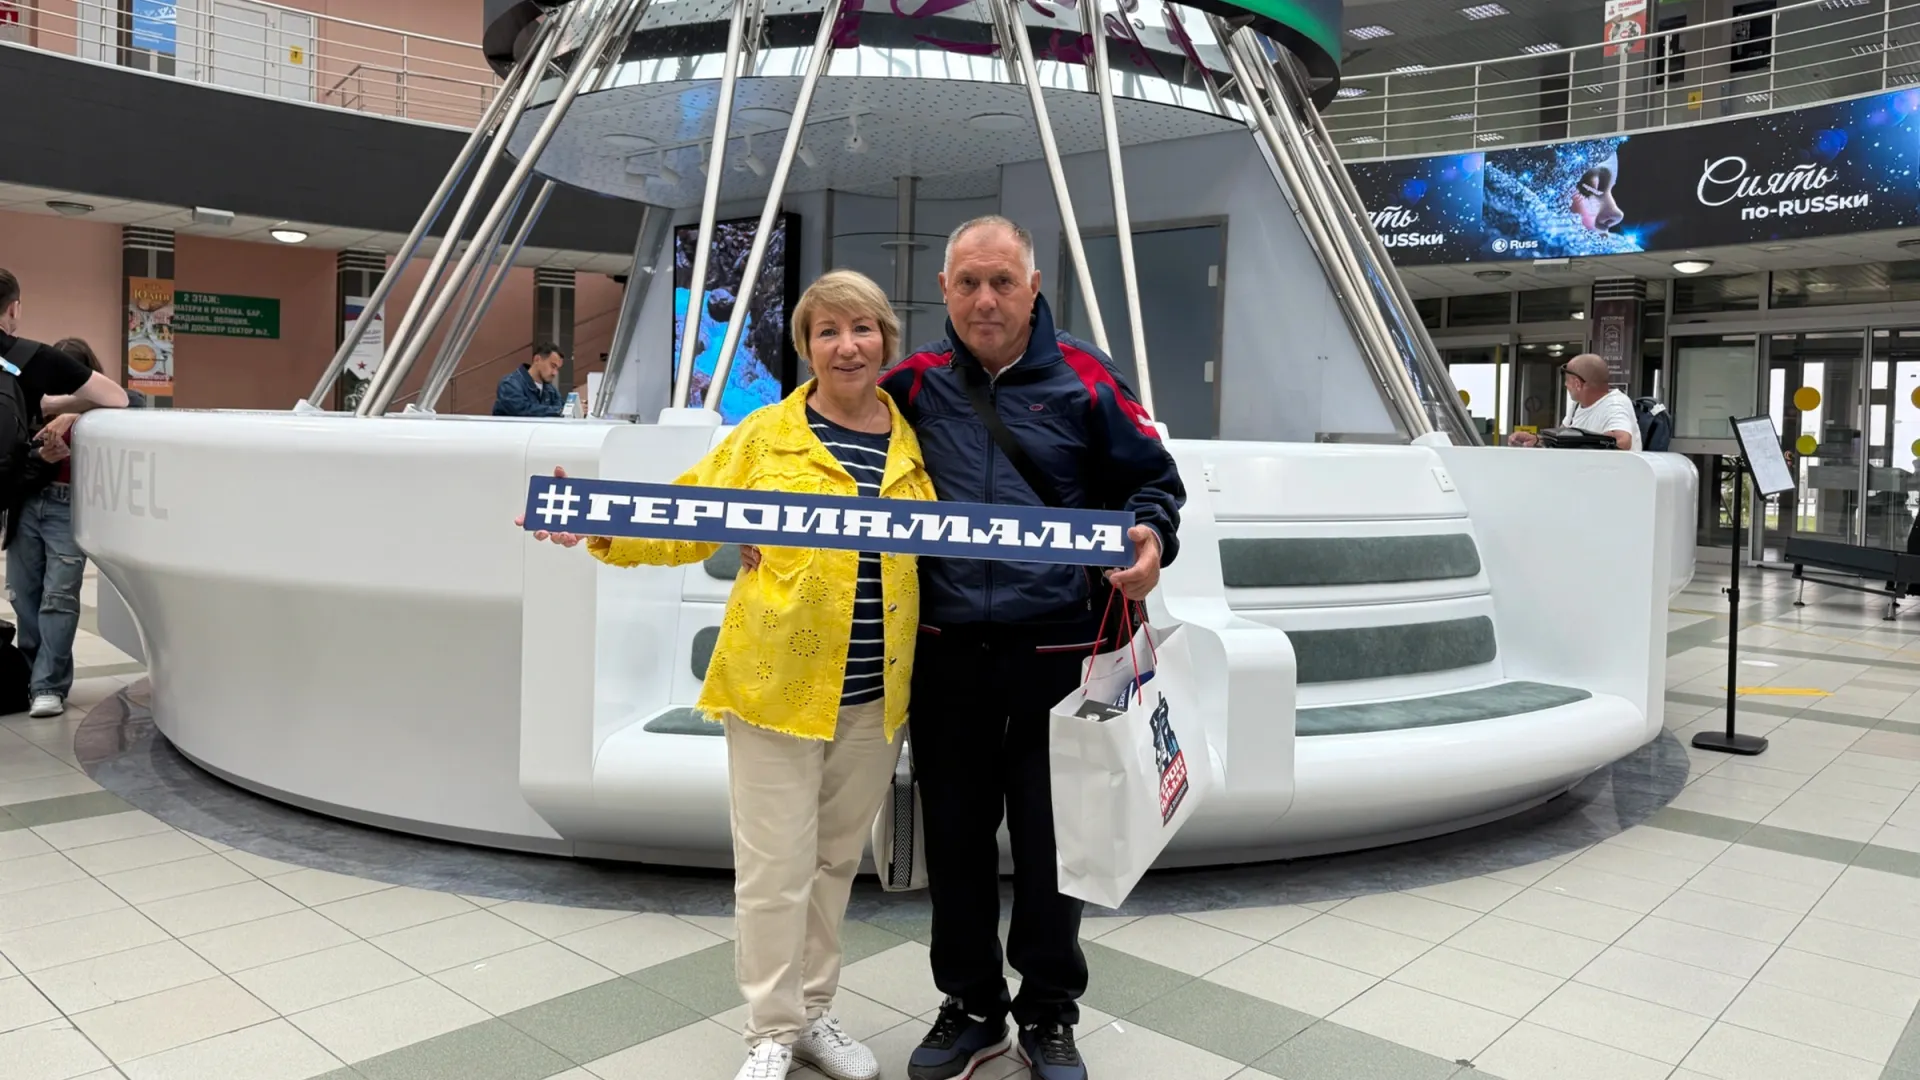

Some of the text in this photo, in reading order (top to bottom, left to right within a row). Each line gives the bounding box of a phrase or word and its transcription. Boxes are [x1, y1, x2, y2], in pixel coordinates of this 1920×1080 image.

[1697, 156, 1837, 206] Сиять
[183, 293, 221, 304] 2 ЭТАЖ:
[227, 327, 254, 335] СЕКТОР
[536, 484, 1125, 552] #ГЕРОИЯМАЛА
